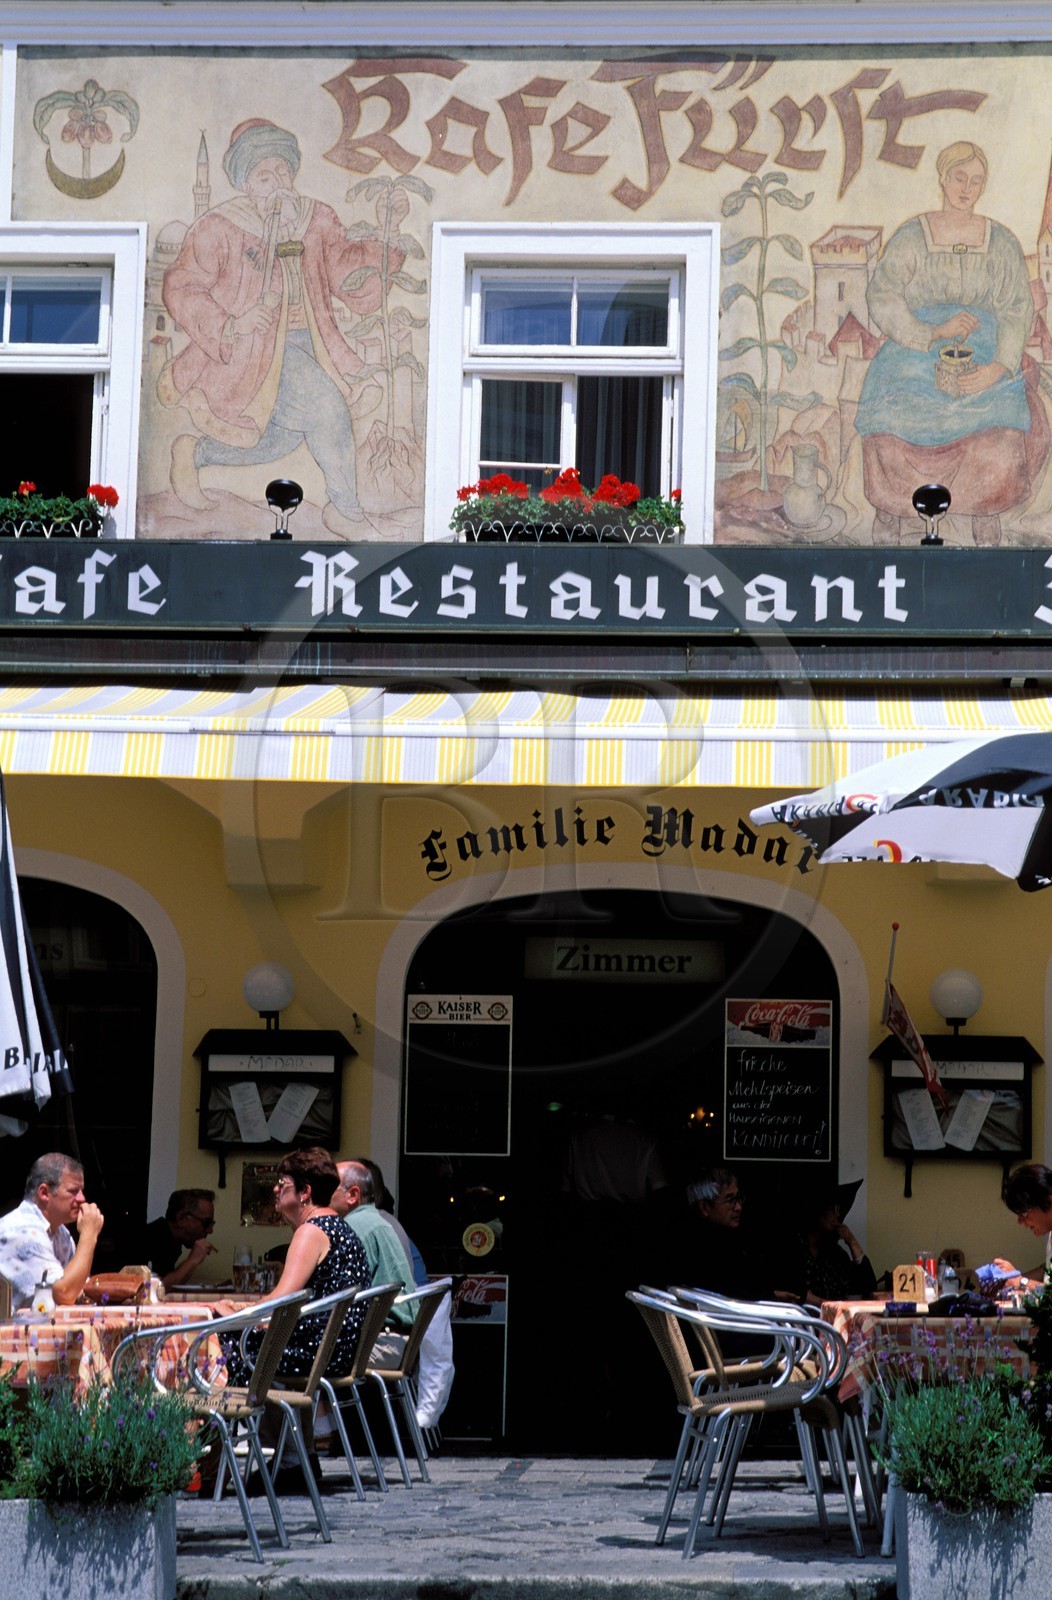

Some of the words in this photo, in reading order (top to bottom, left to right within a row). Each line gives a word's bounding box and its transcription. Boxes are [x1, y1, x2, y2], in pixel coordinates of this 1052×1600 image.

[0, 548, 167, 620] afe
[294, 549, 909, 623] Restaurant
[418, 805, 617, 882] Familie
[555, 945, 693, 974] Zimmer
[437, 1001, 482, 1015] KAISER
[448, 1013, 472, 1021] BIER
[744, 1002, 812, 1026] Coca-Cola
[899, 1273, 917, 1293] 21
